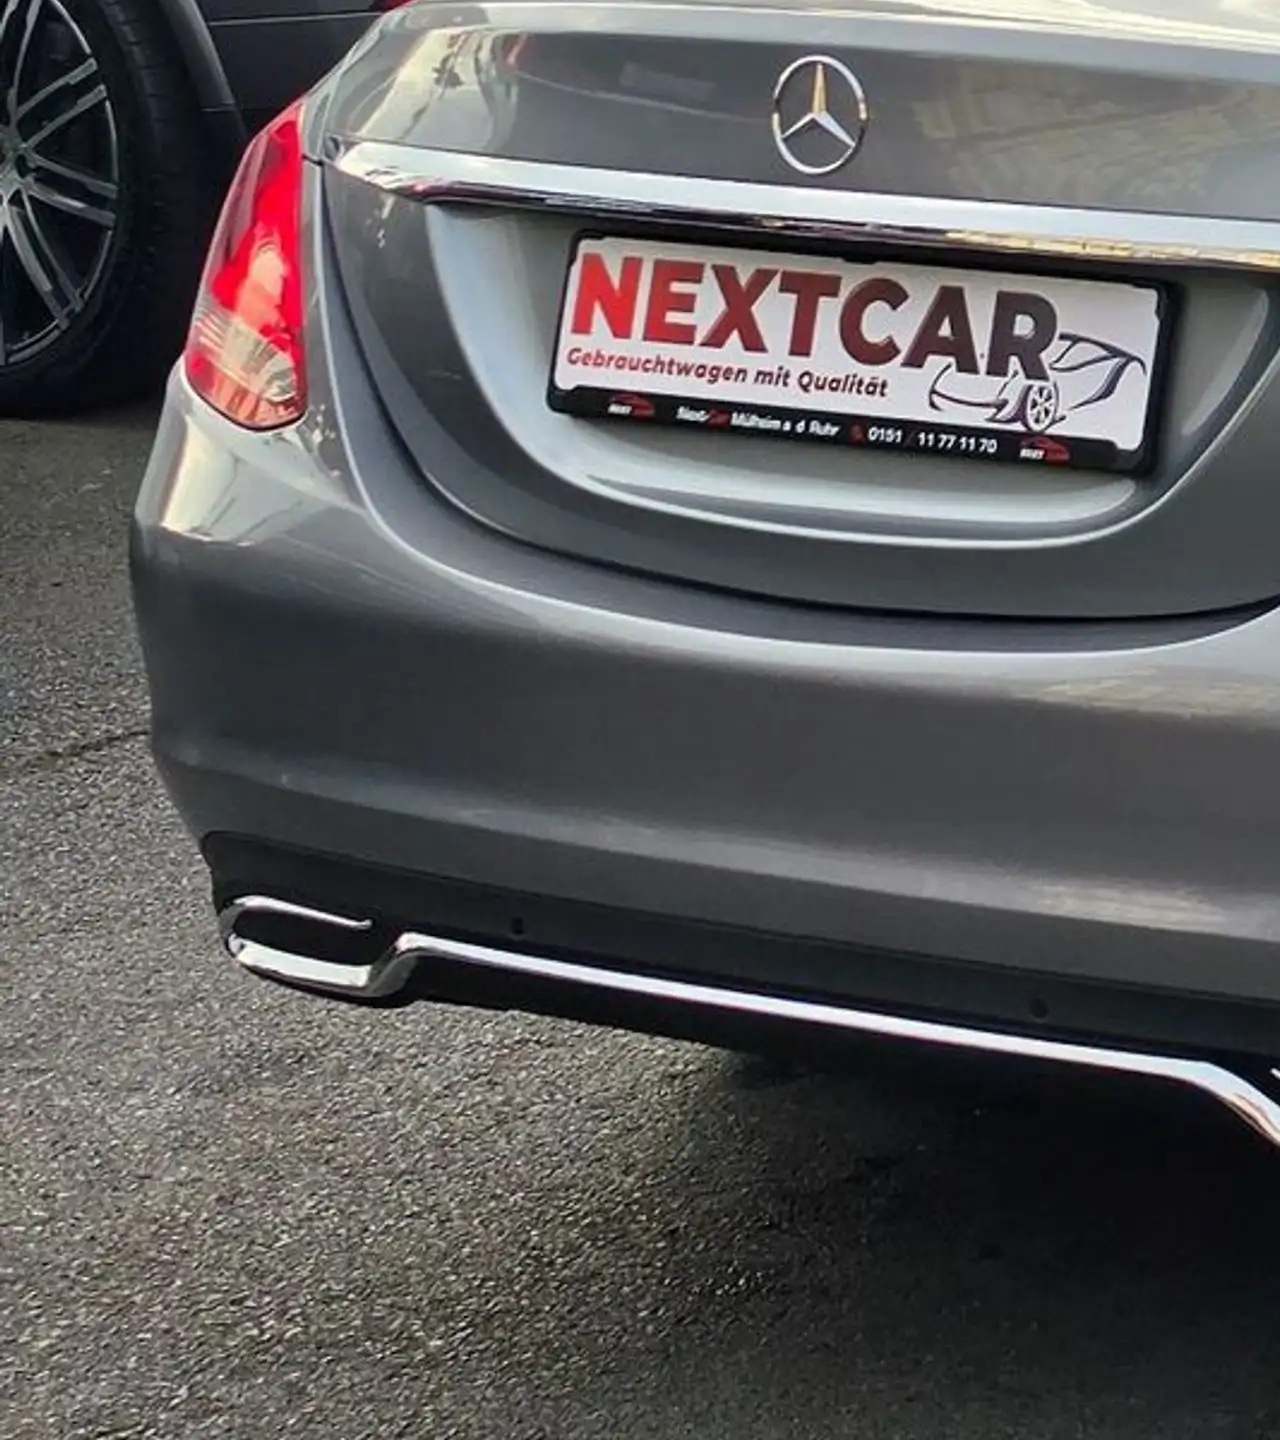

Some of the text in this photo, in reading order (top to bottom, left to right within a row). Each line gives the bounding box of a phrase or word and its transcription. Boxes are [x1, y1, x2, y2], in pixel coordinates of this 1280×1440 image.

[570, 251, 1058, 382] NEXTCAR
[566, 346, 889, 399] Gebrauchtwagen mit Qualität
[868, 426, 903, 444] 0151
